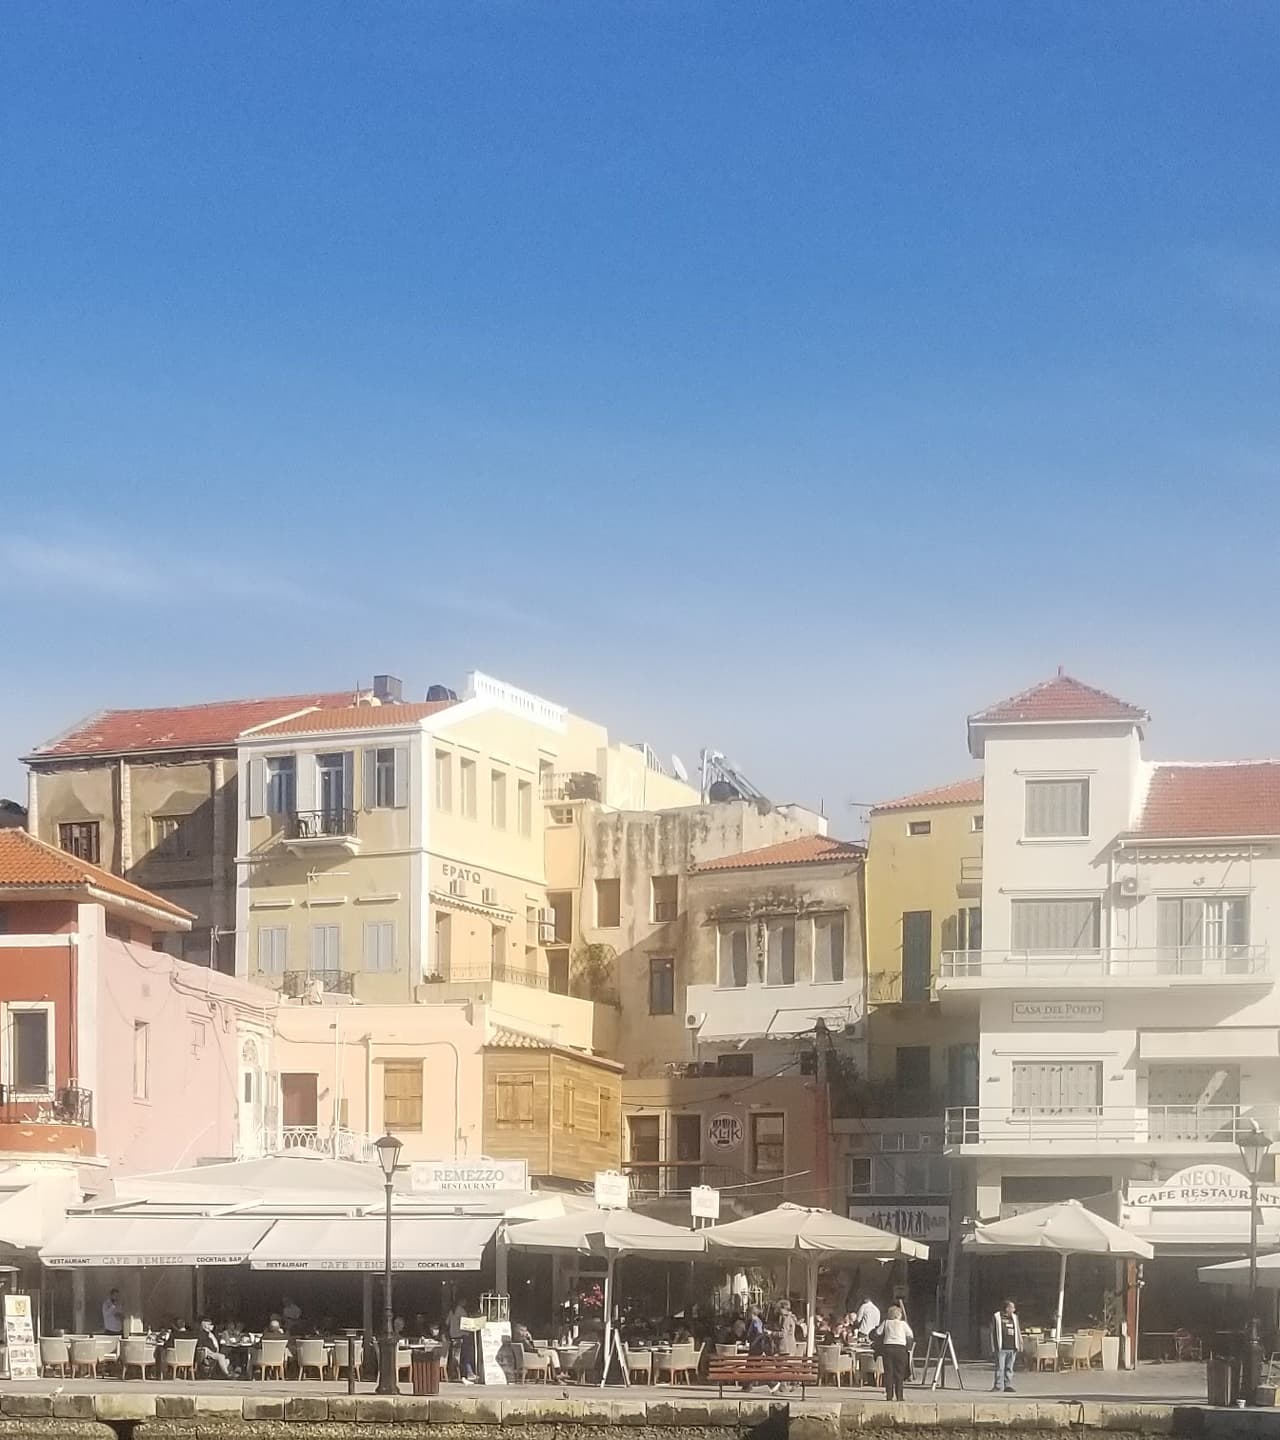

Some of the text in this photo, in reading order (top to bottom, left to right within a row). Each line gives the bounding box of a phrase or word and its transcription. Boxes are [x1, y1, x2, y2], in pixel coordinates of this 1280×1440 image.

[433, 1169, 504, 1182] REMEZZO
[1179, 1170, 1232, 1186] NEON
[441, 1183, 497, 1191] RESTAURANT
[1137, 1190, 1176, 1204] CAFE
